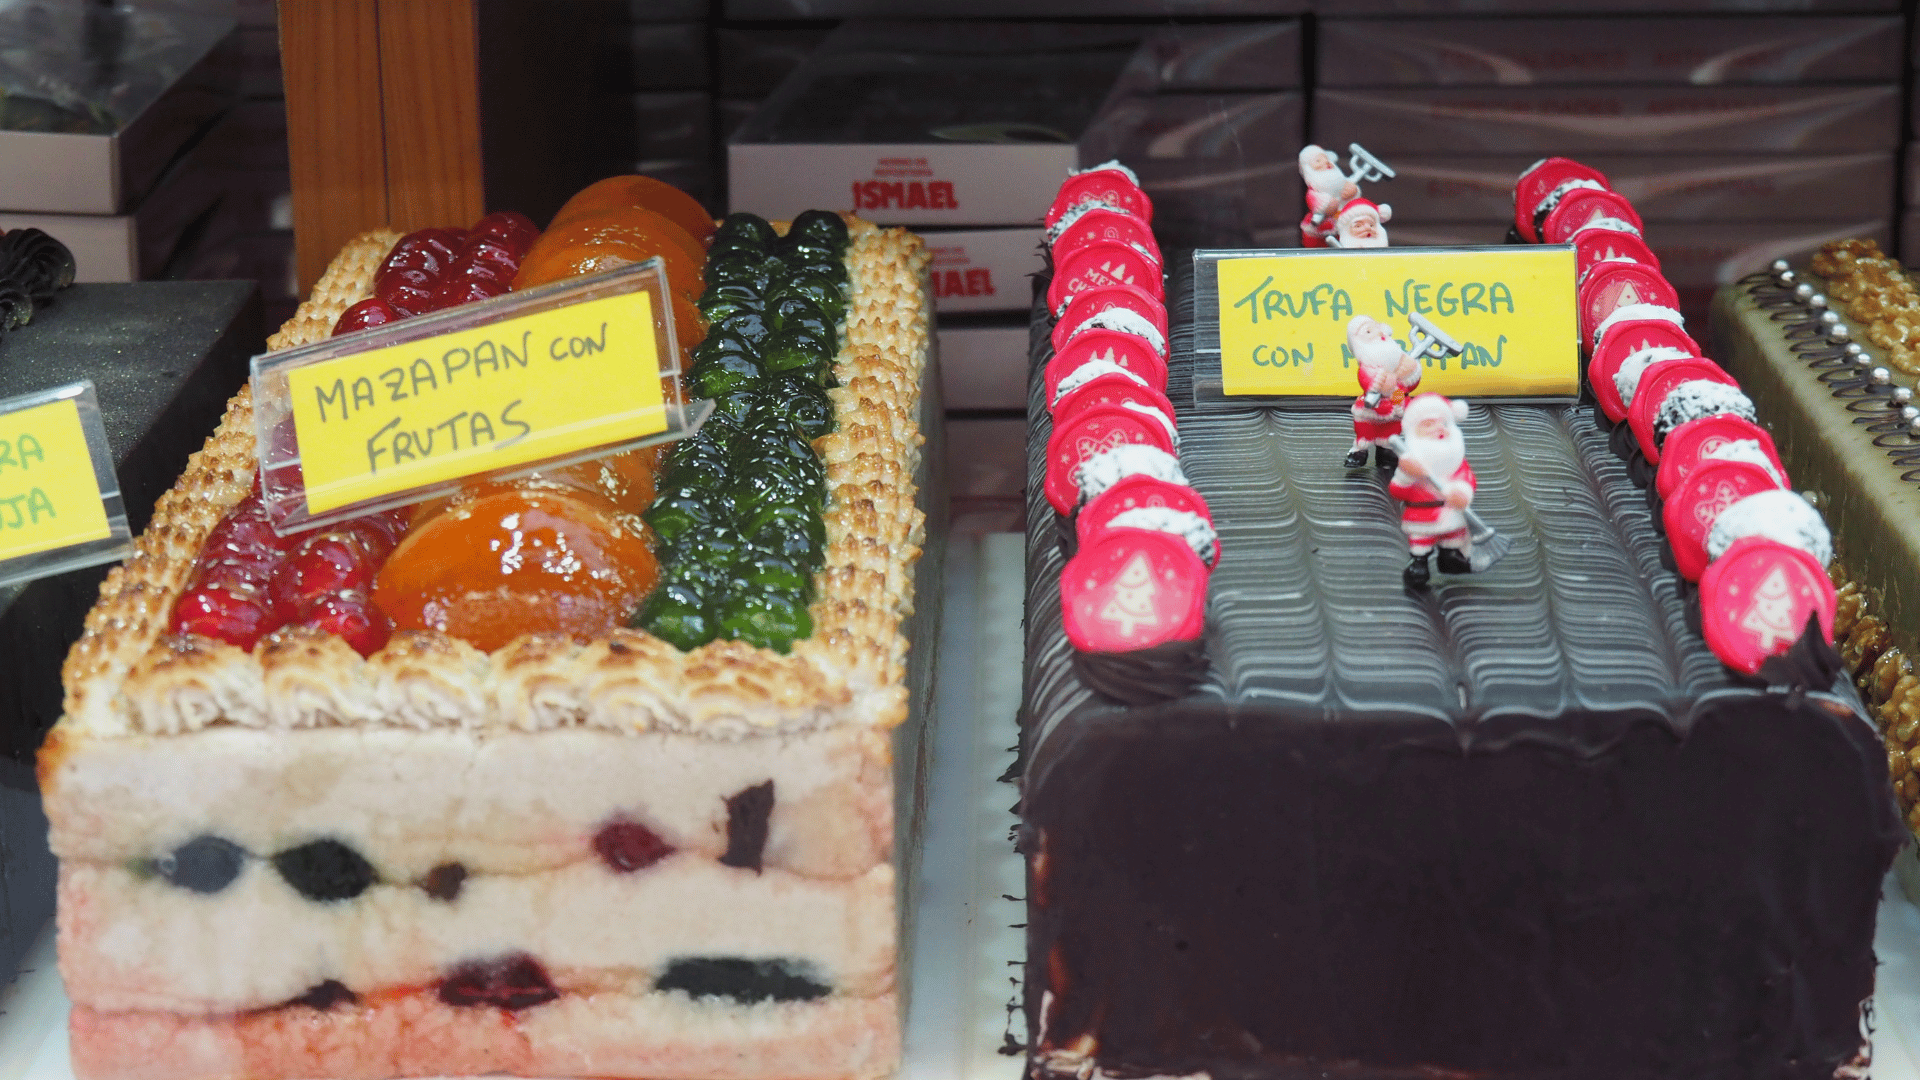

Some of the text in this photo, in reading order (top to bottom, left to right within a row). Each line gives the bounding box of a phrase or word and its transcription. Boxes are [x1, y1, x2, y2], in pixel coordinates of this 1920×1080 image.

[852, 181, 959, 210] ISMAEL
[1234, 276, 1514, 323] TRUFA NEGRA
[315, 331, 532, 423] MAZAPAN
[1252, 342, 1314, 368] CON
[367, 400, 531, 475] FRUTAS
[0, 487, 56, 529] JA
